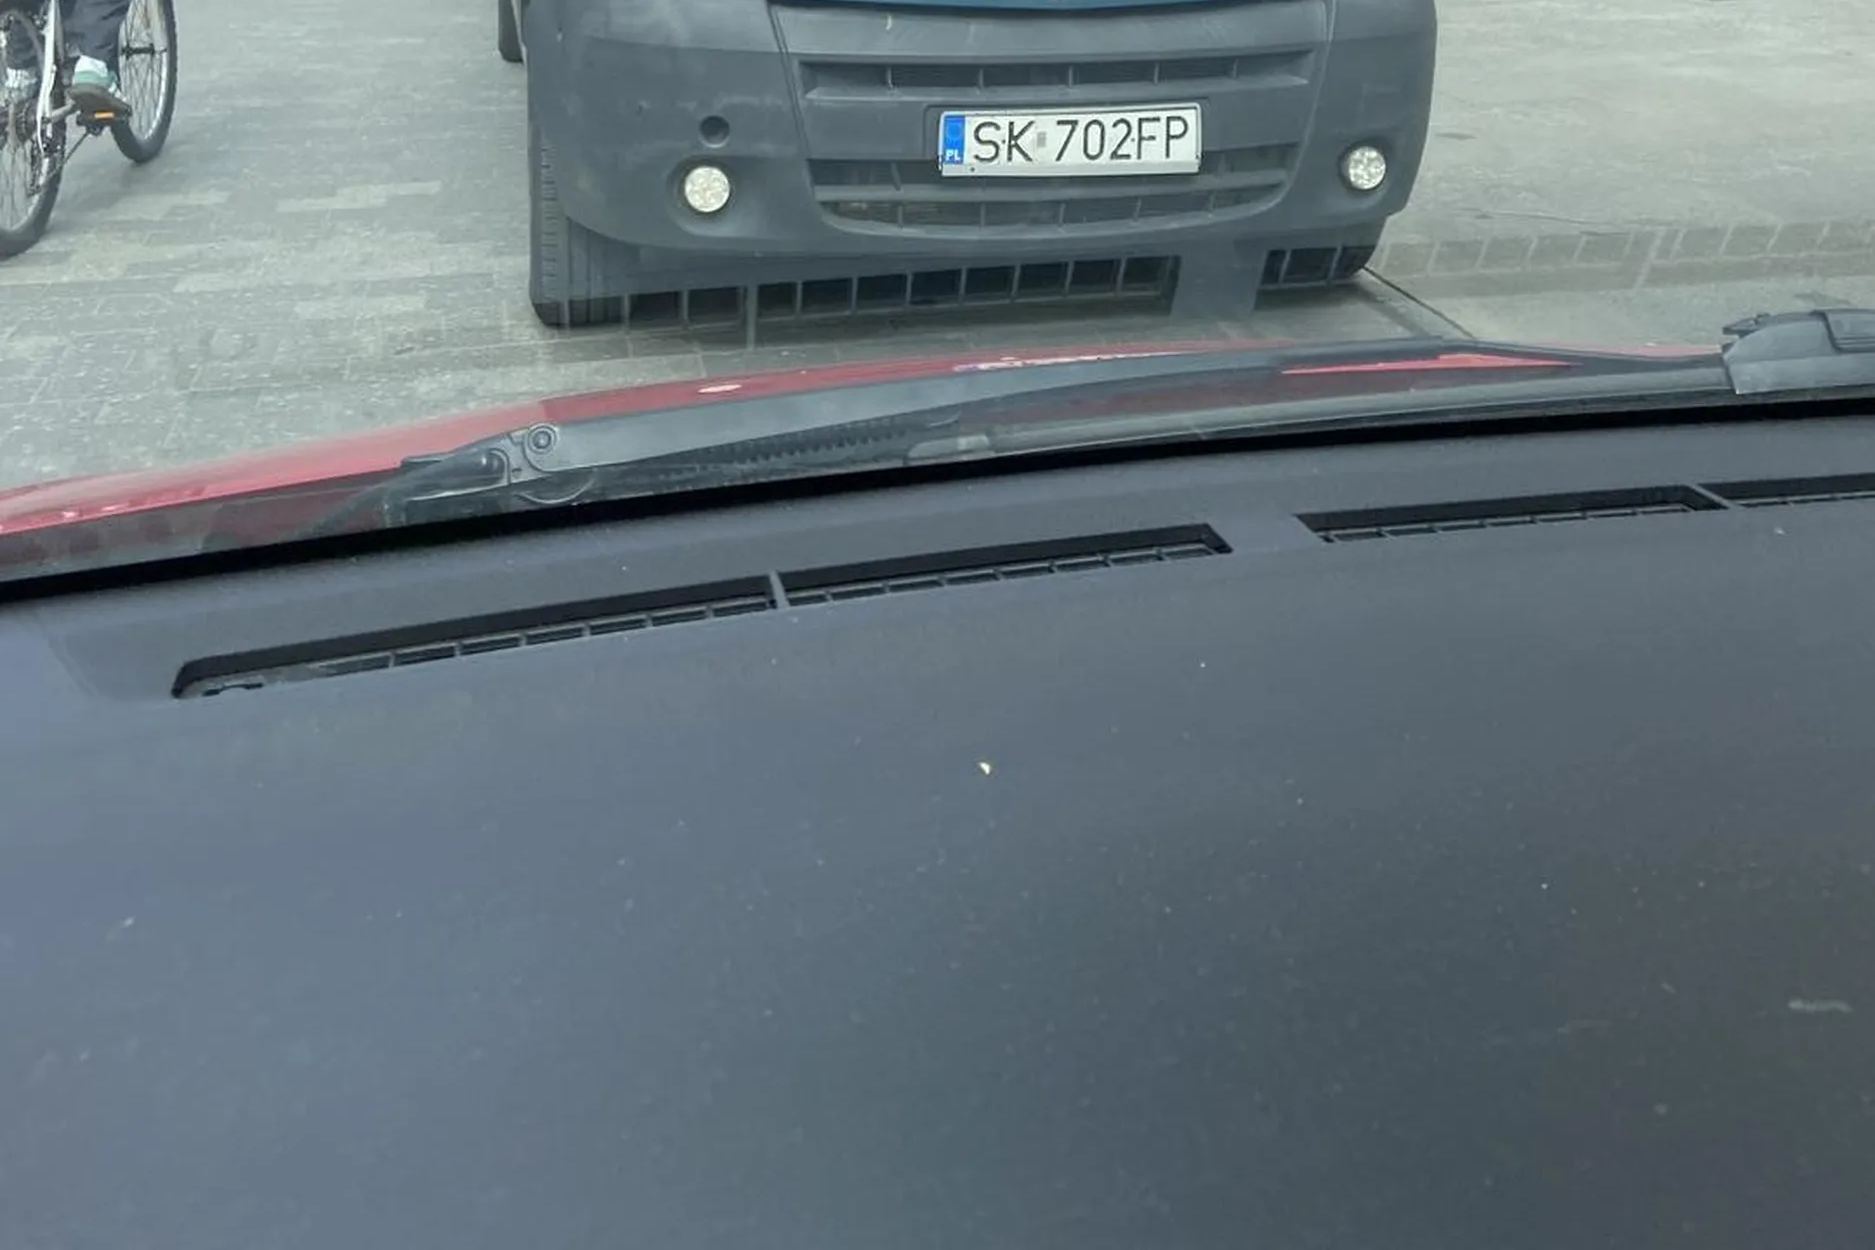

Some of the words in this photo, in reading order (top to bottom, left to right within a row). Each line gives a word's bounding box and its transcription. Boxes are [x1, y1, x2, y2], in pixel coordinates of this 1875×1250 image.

[972, 119, 1036, 163] SK
[1054, 115, 1189, 162] 702FP
[945, 149, 961, 161] PL
